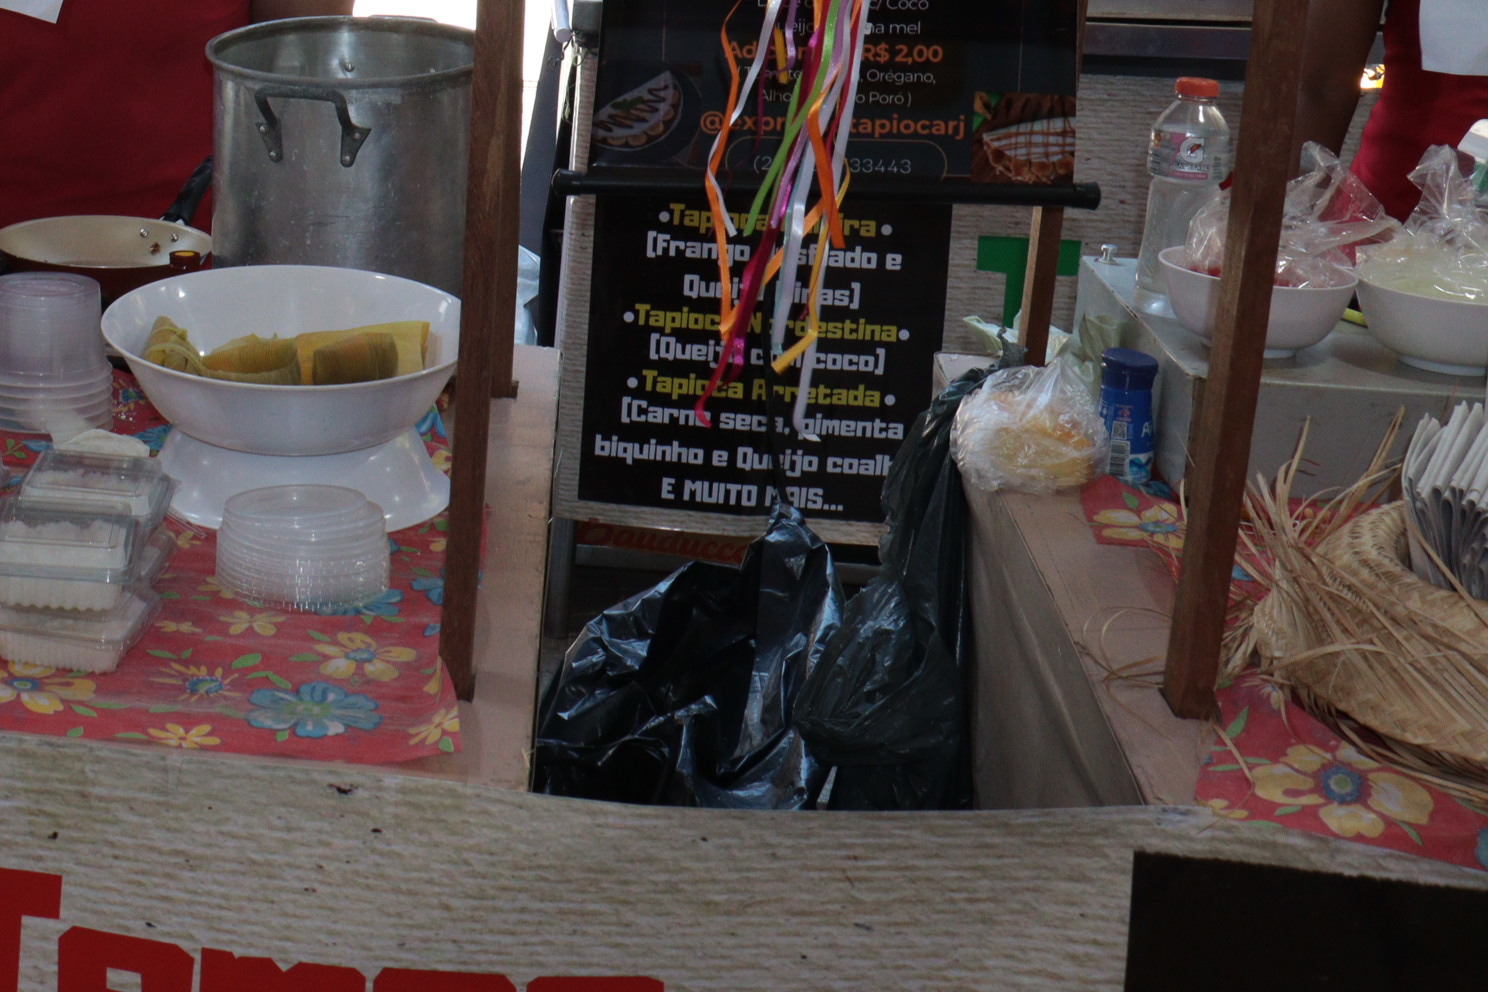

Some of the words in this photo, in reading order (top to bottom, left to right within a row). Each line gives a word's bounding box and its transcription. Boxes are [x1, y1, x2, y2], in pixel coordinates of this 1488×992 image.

[889, 20, 921, 35] mel
[895, 44, 943, 65] 2,00
[867, 69, 936, 86] Orégano,
[869, 90, 904, 105] Poró
[700, 110, 965, 139] @exprtapiocarj
[886, 253, 902, 270] e
[635, 303, 727, 334] Tapioc
[748, 315, 897, 342] Nrdestina
[799, 413, 904, 440] pimenta
[594, 434, 703, 464] biquinho
[712, 449, 727, 467] e
[661, 477, 675, 499] E
[683, 478, 757, 507] MUITO
